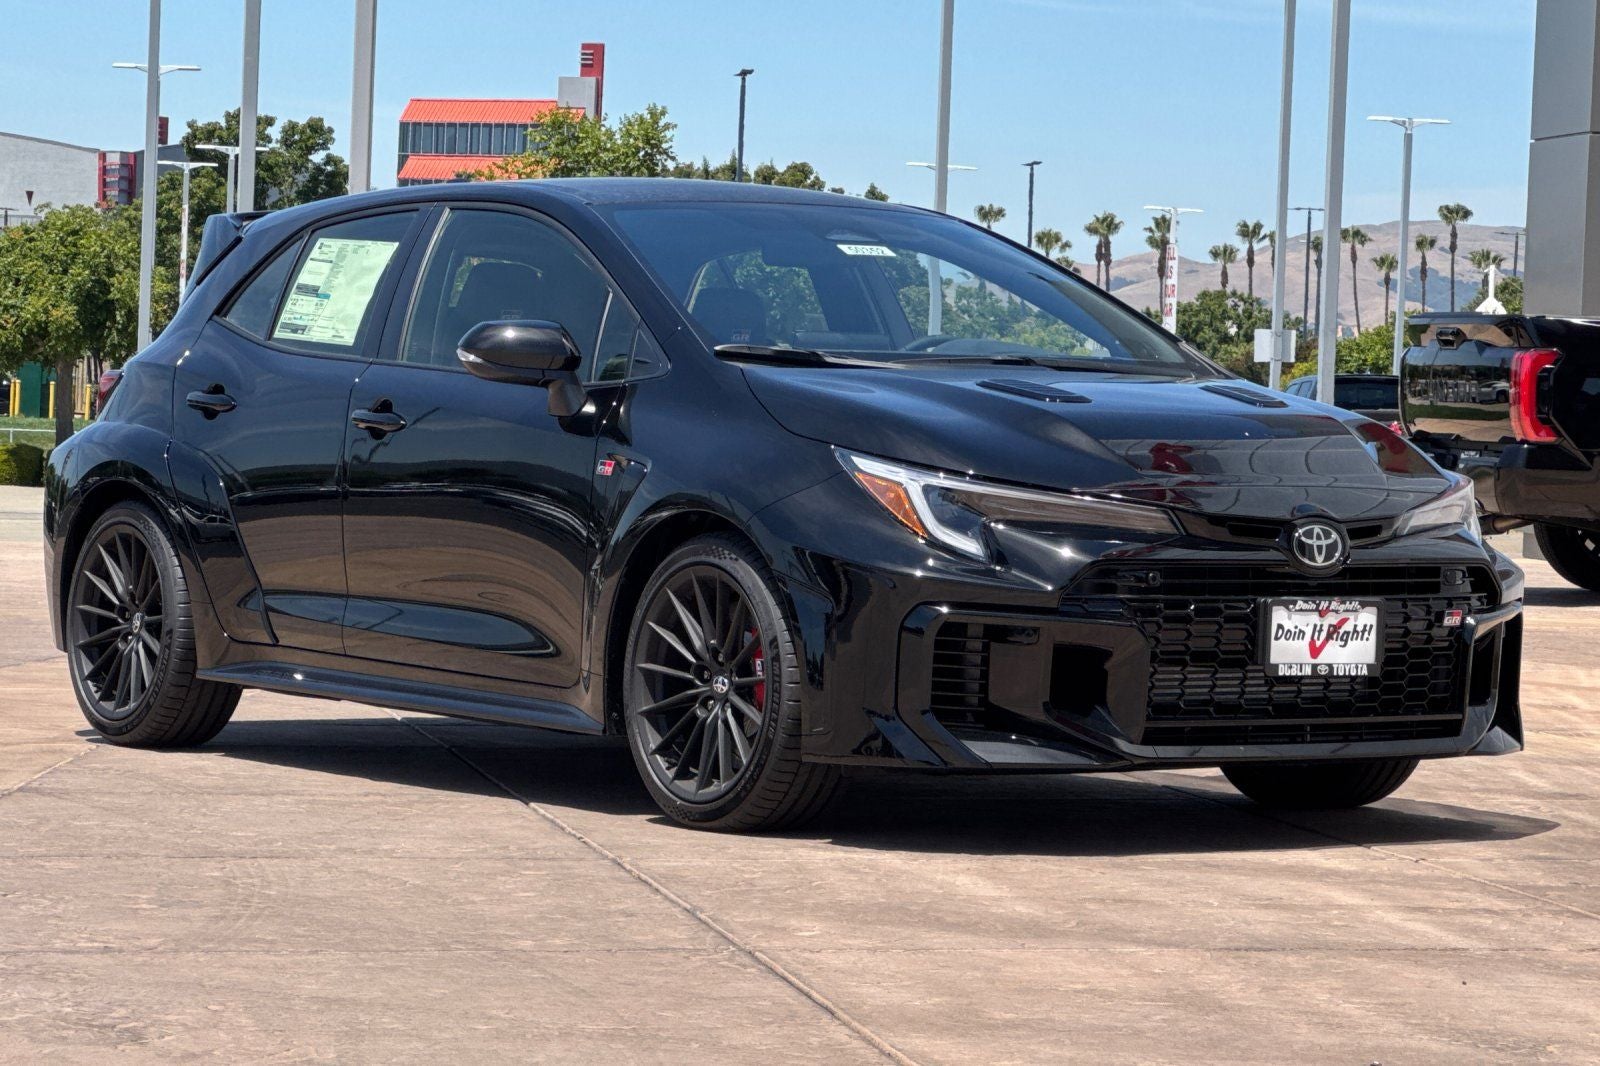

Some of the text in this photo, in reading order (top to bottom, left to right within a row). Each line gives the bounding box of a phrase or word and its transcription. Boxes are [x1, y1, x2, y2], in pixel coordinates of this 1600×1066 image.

[1273, 623, 1374, 648] Doin' It Right!
[1278, 663, 1369, 676] DUBLIN TOYOTA
